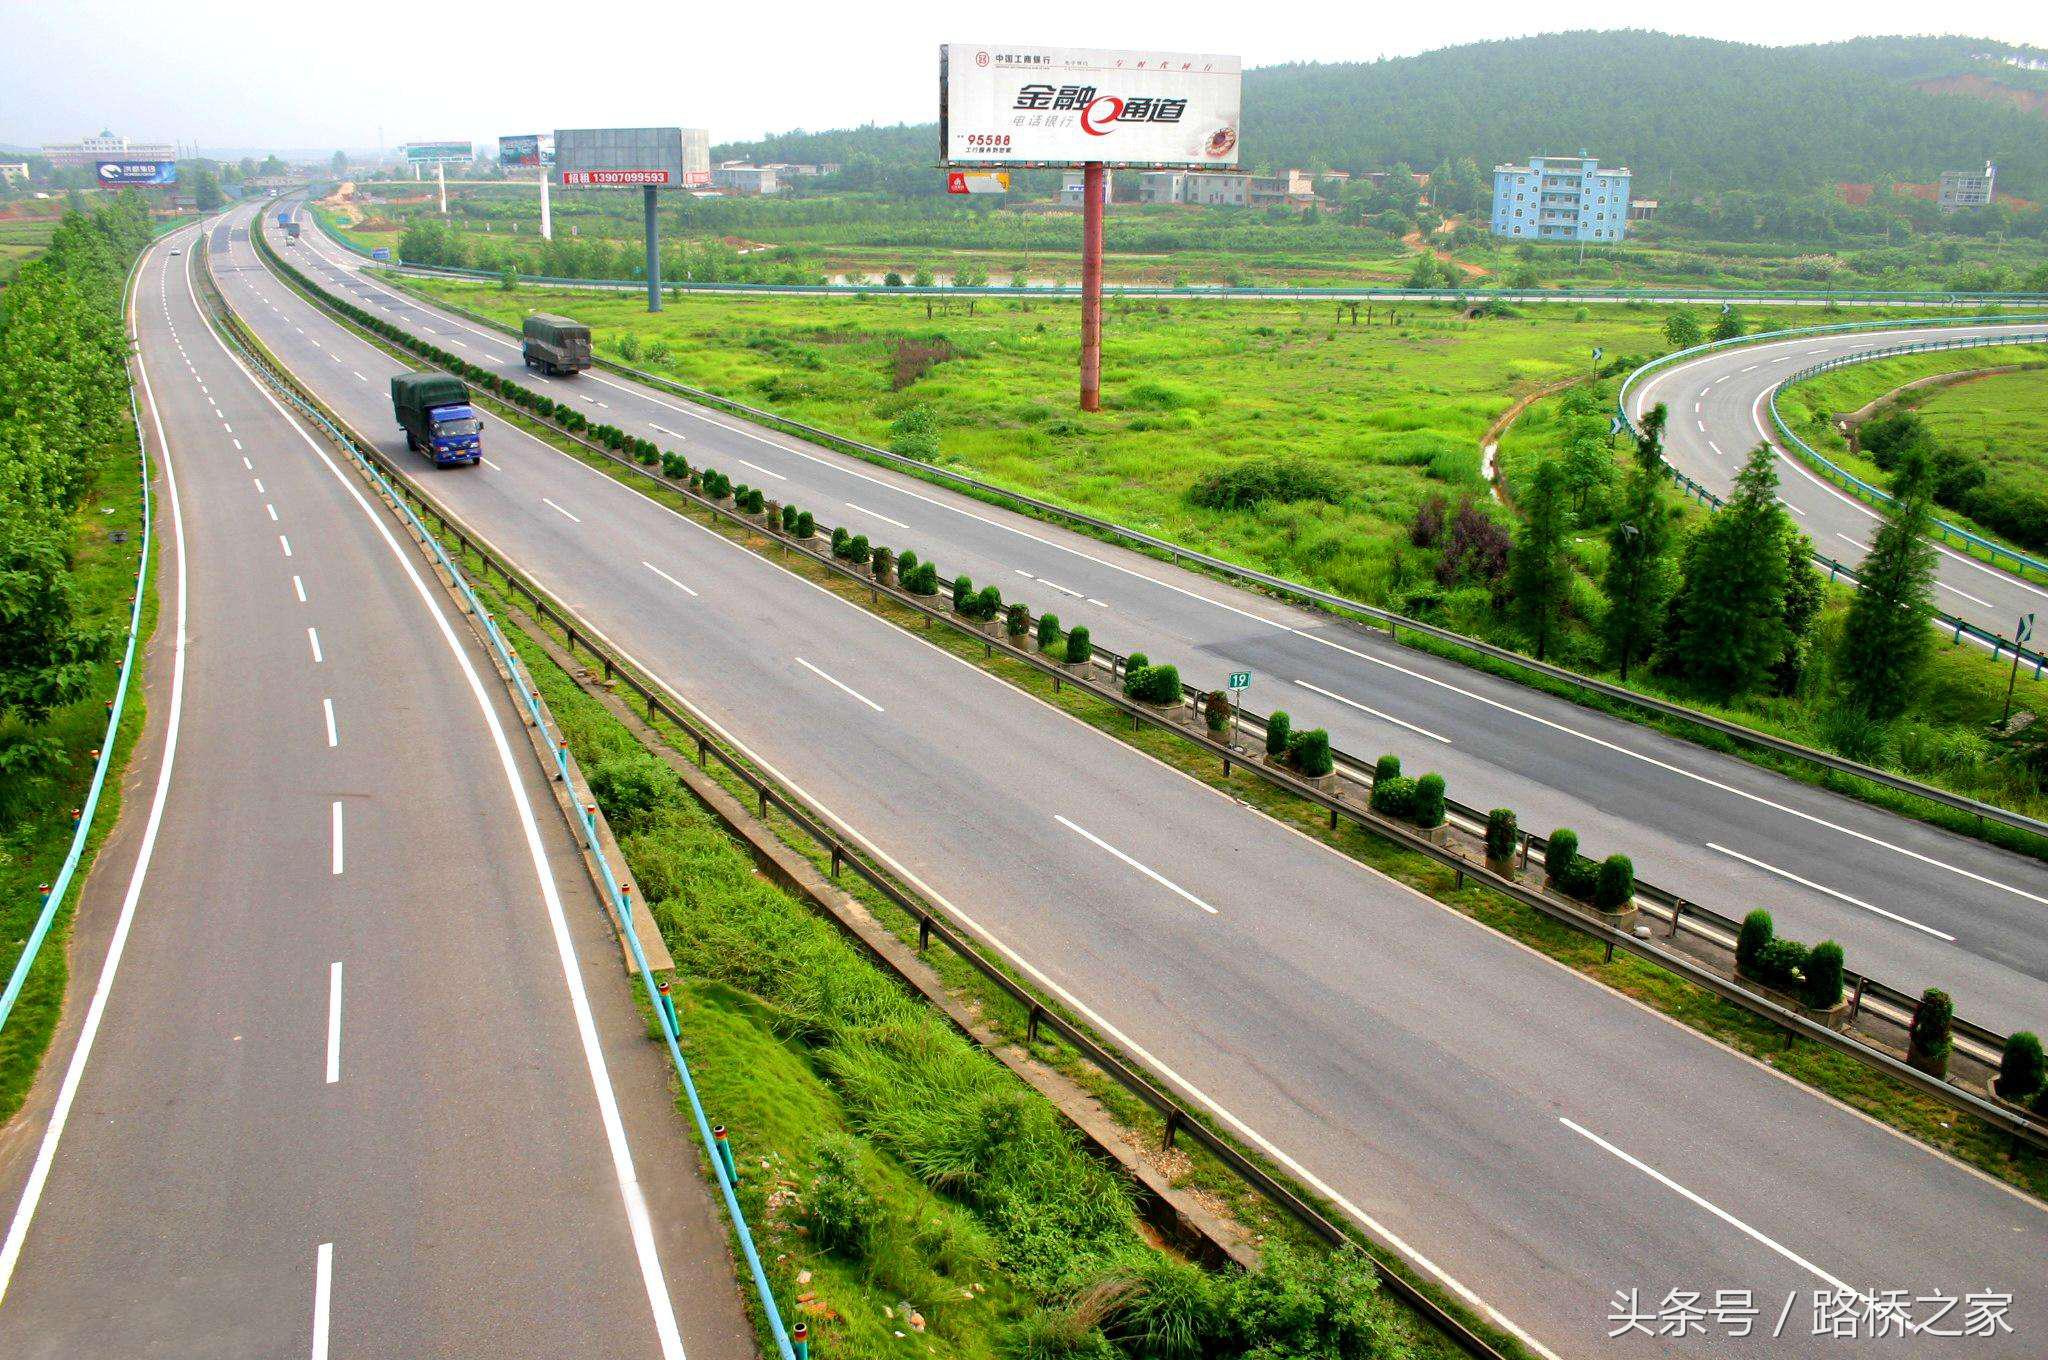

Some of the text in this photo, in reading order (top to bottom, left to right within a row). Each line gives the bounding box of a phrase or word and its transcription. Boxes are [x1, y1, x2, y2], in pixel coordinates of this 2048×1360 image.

[995, 54, 1051, 65] 中国工商银行
[1013, 115, 1074, 128] 电话银行
[967, 134, 1011, 146] 95588
[568, 171, 665, 184] 招租 13907099593
[1233, 674, 1246, 687] 19
